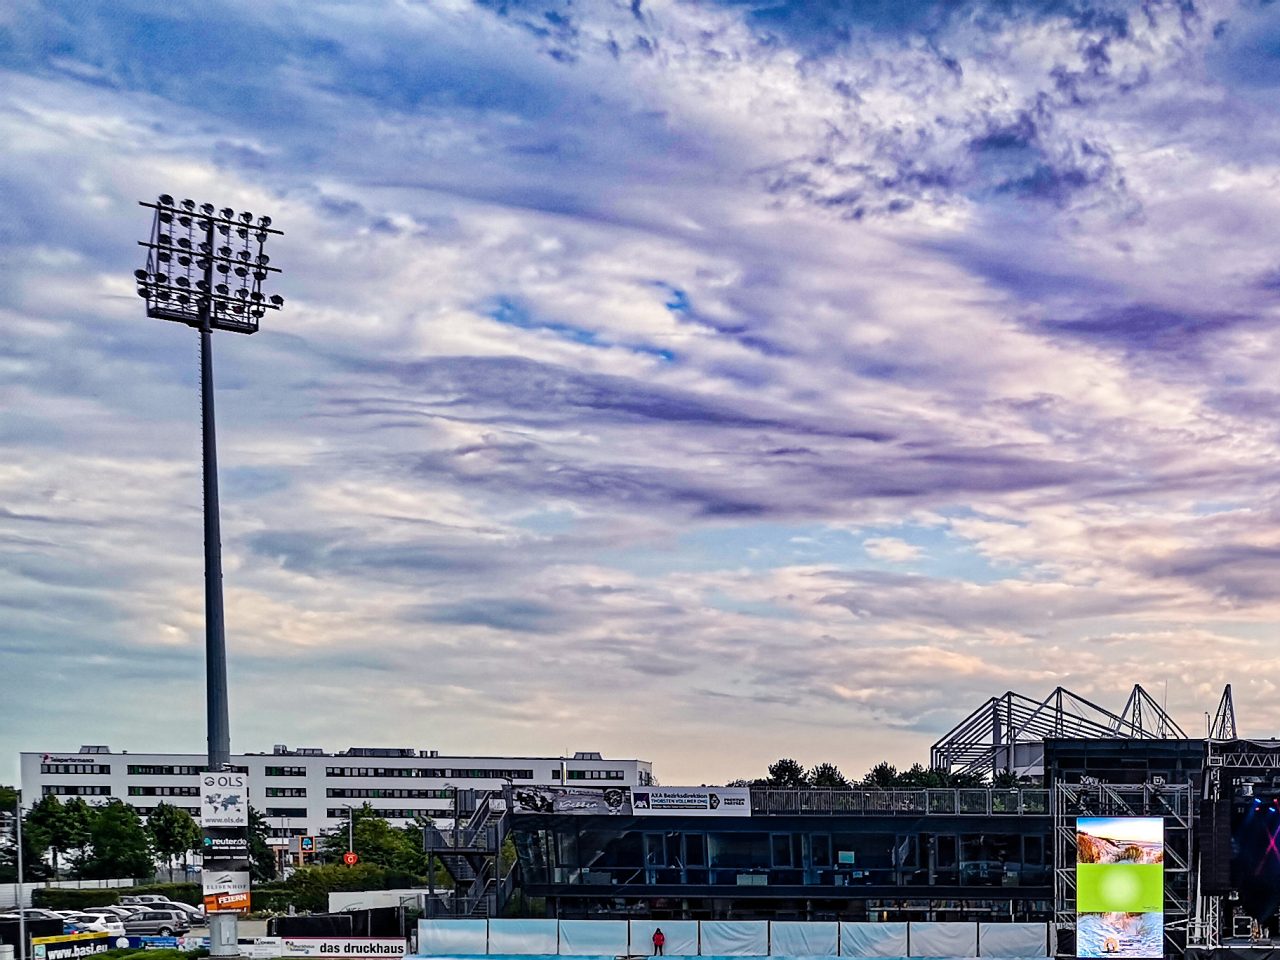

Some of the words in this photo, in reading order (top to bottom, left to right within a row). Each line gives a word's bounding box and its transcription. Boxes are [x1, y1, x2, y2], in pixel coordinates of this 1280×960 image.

[218, 777, 243, 787] OLS
[48, 943, 108, 960] www.basi.eu
[320, 943, 340, 954] das
[344, 943, 404, 954] druckhaus
